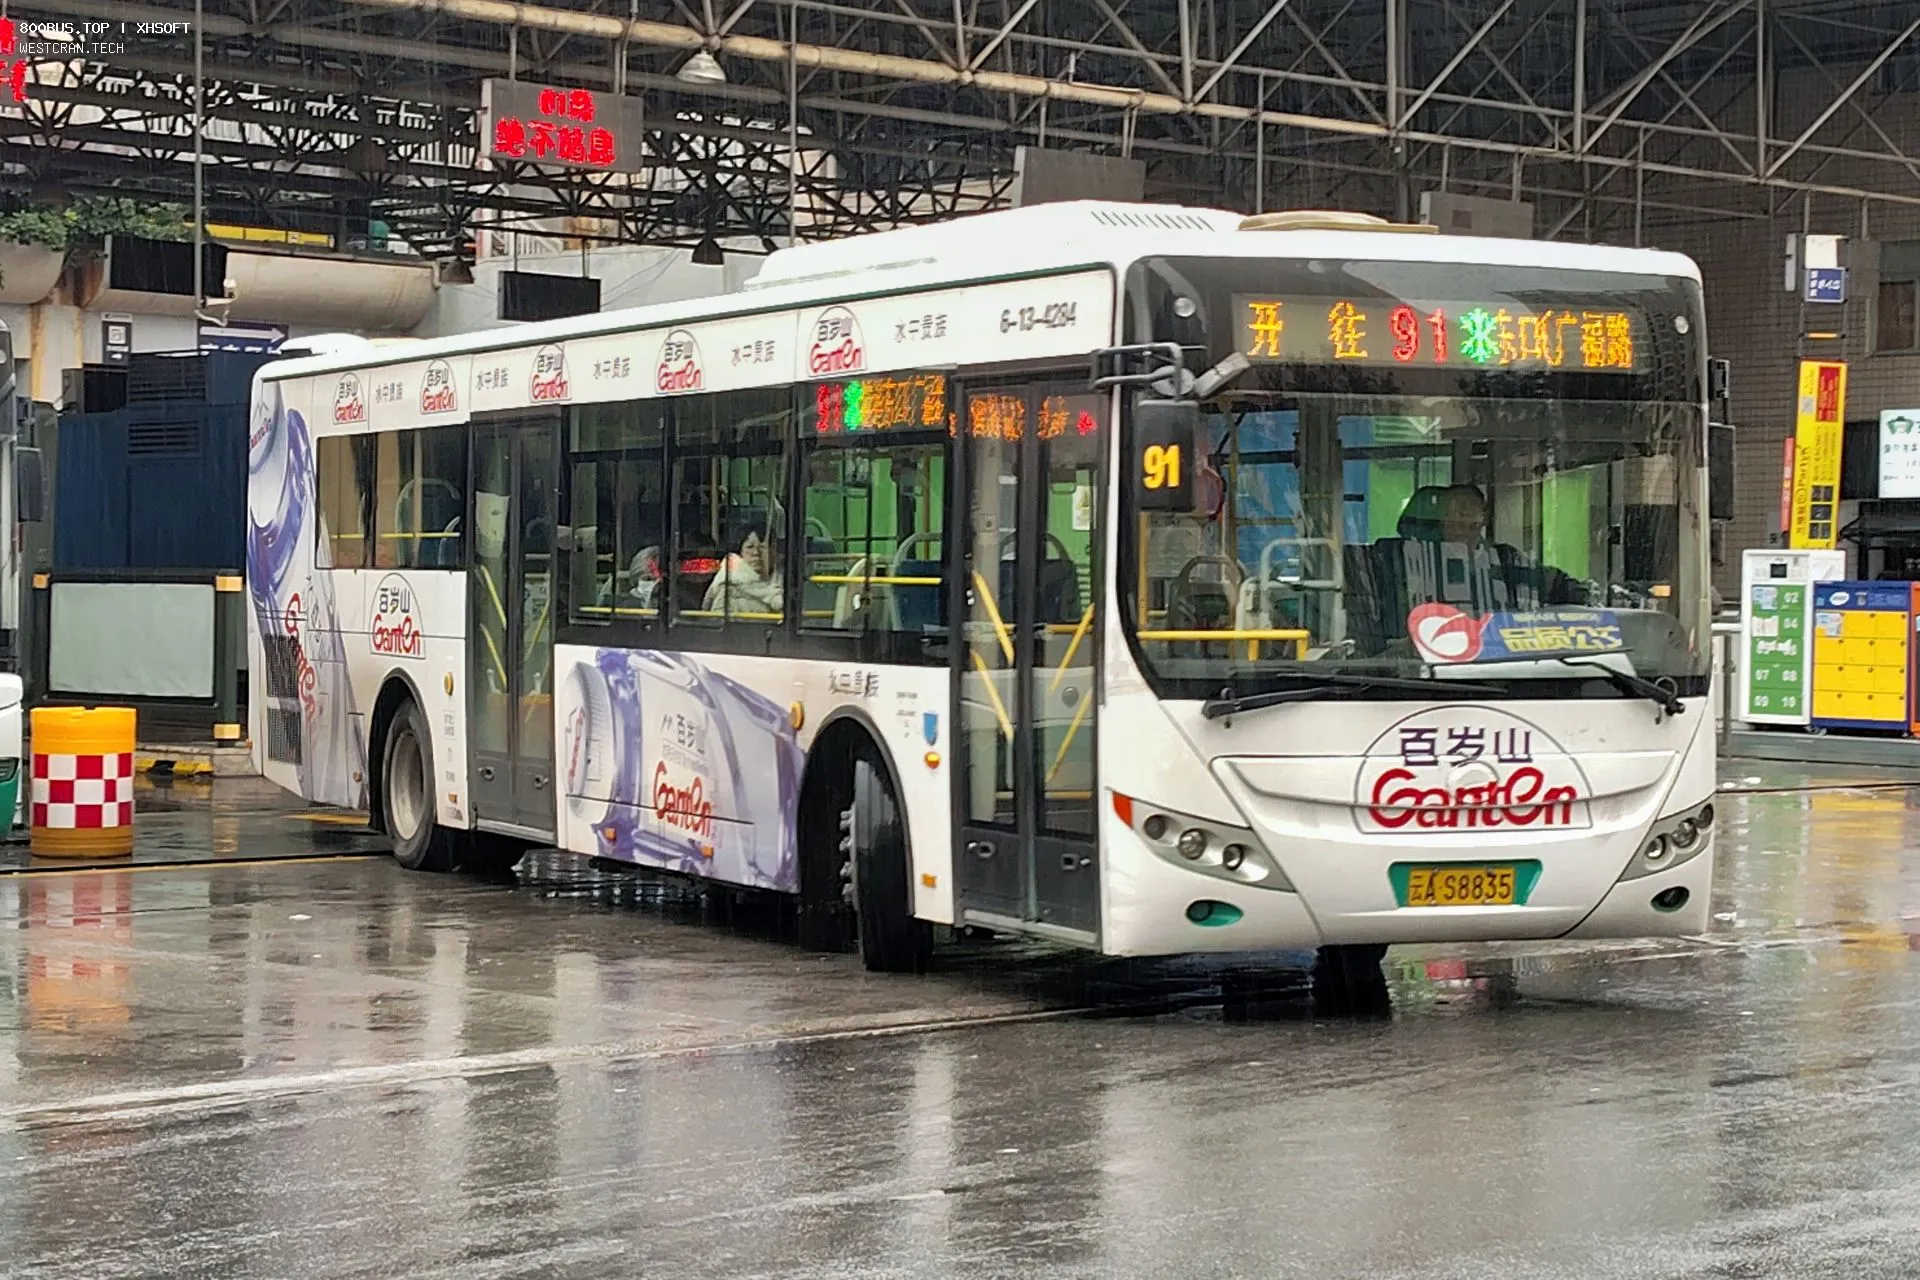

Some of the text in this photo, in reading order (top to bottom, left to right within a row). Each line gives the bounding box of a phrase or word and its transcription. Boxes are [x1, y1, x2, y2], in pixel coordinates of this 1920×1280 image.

[1389, 305, 1449, 363] 91
[1143, 444, 1180, 489] 91
[379, 586, 411, 615] 百岁山
[1398, 726, 1533, 767] 百岁山
